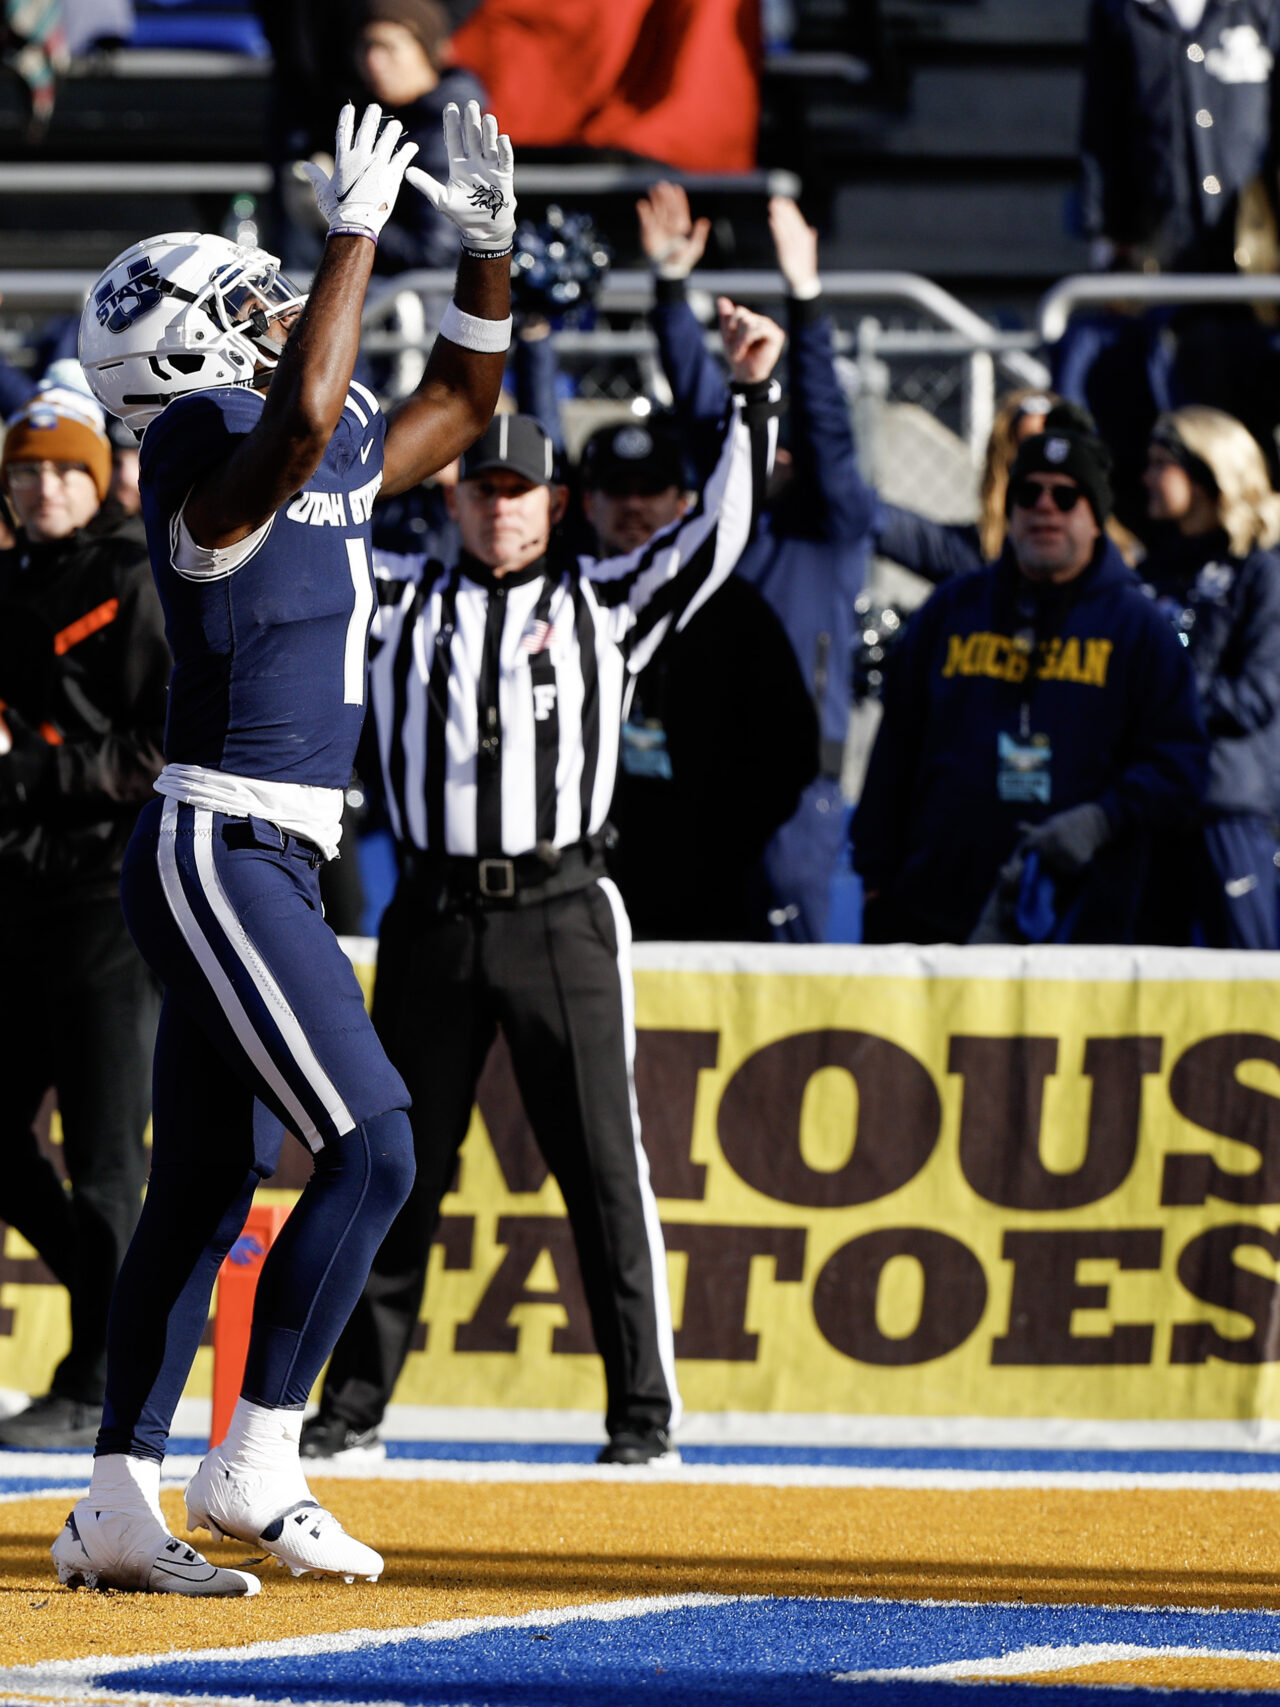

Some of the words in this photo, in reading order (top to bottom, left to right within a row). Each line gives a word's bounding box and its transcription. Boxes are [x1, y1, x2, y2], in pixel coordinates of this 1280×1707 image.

[286, 491, 347, 526] UTAH
[344, 537, 373, 706] 1
[533, 684, 557, 720] F
